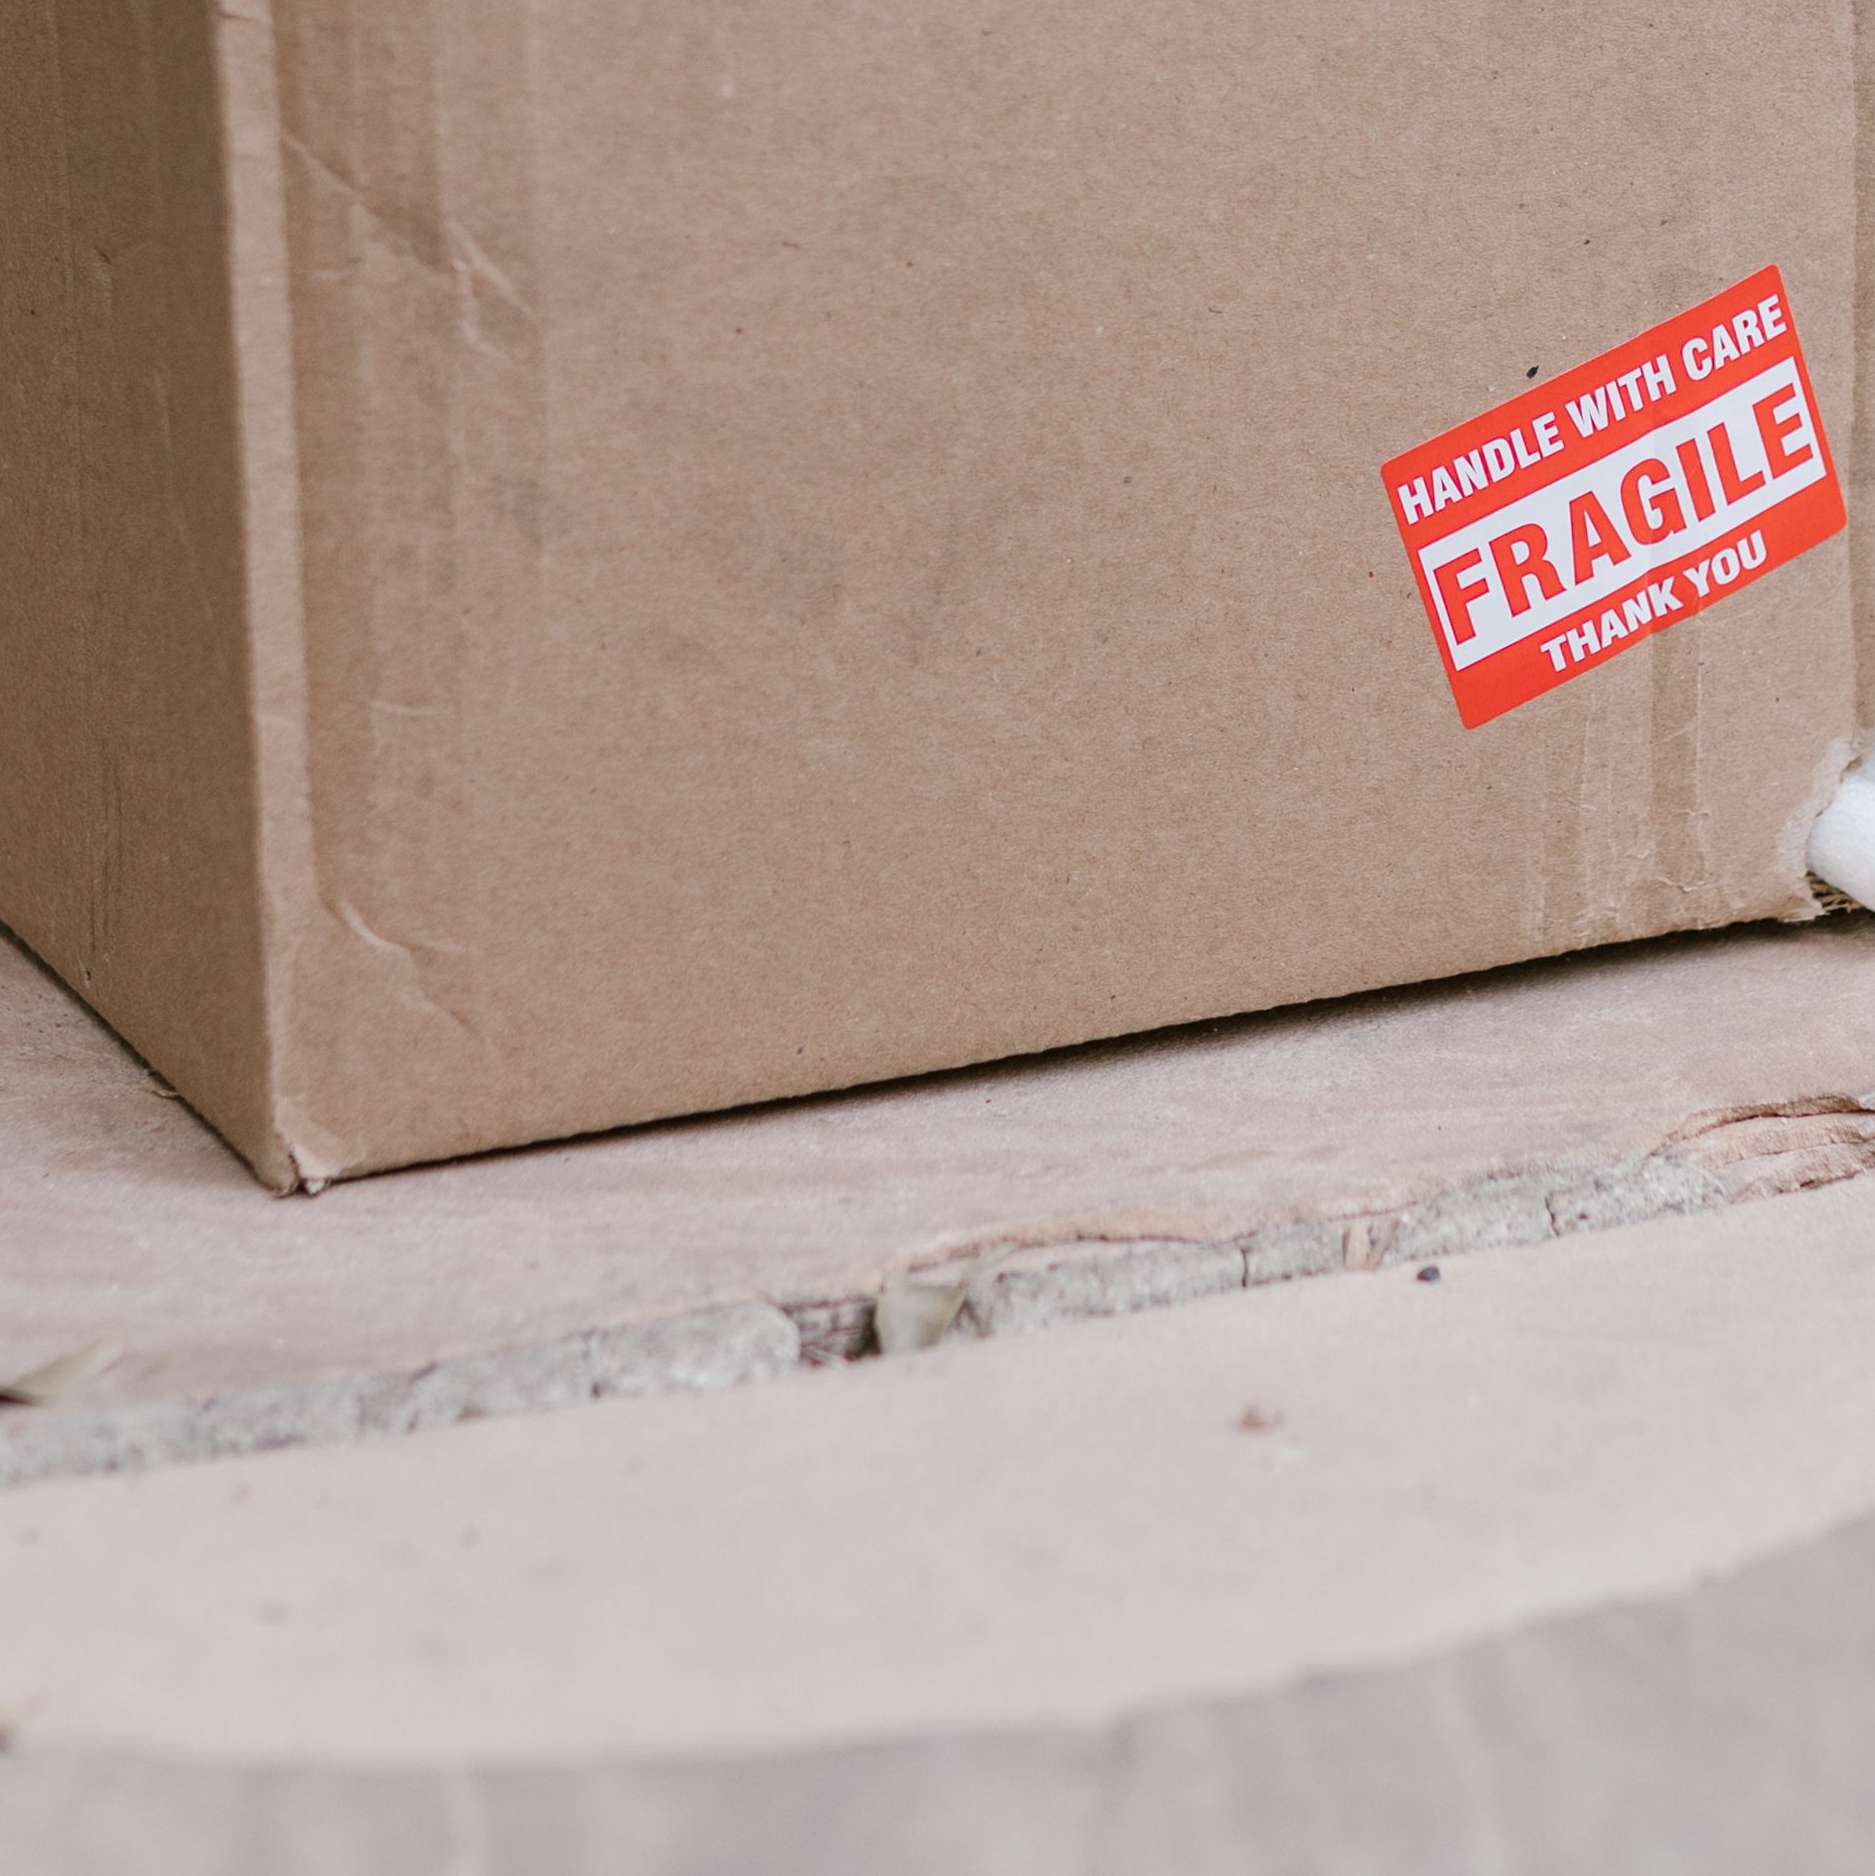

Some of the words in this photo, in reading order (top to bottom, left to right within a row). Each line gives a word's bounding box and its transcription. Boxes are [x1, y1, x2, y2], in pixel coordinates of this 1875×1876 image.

[1397, 411, 1565, 525] HANDLE
[1565, 354, 1677, 438] WITH
[1682, 294, 1788, 381] CARE
[1432, 382, 1814, 646] FRAGILE
[1540, 576, 1684, 672] THANK
[1683, 530, 1768, 598] YOU
